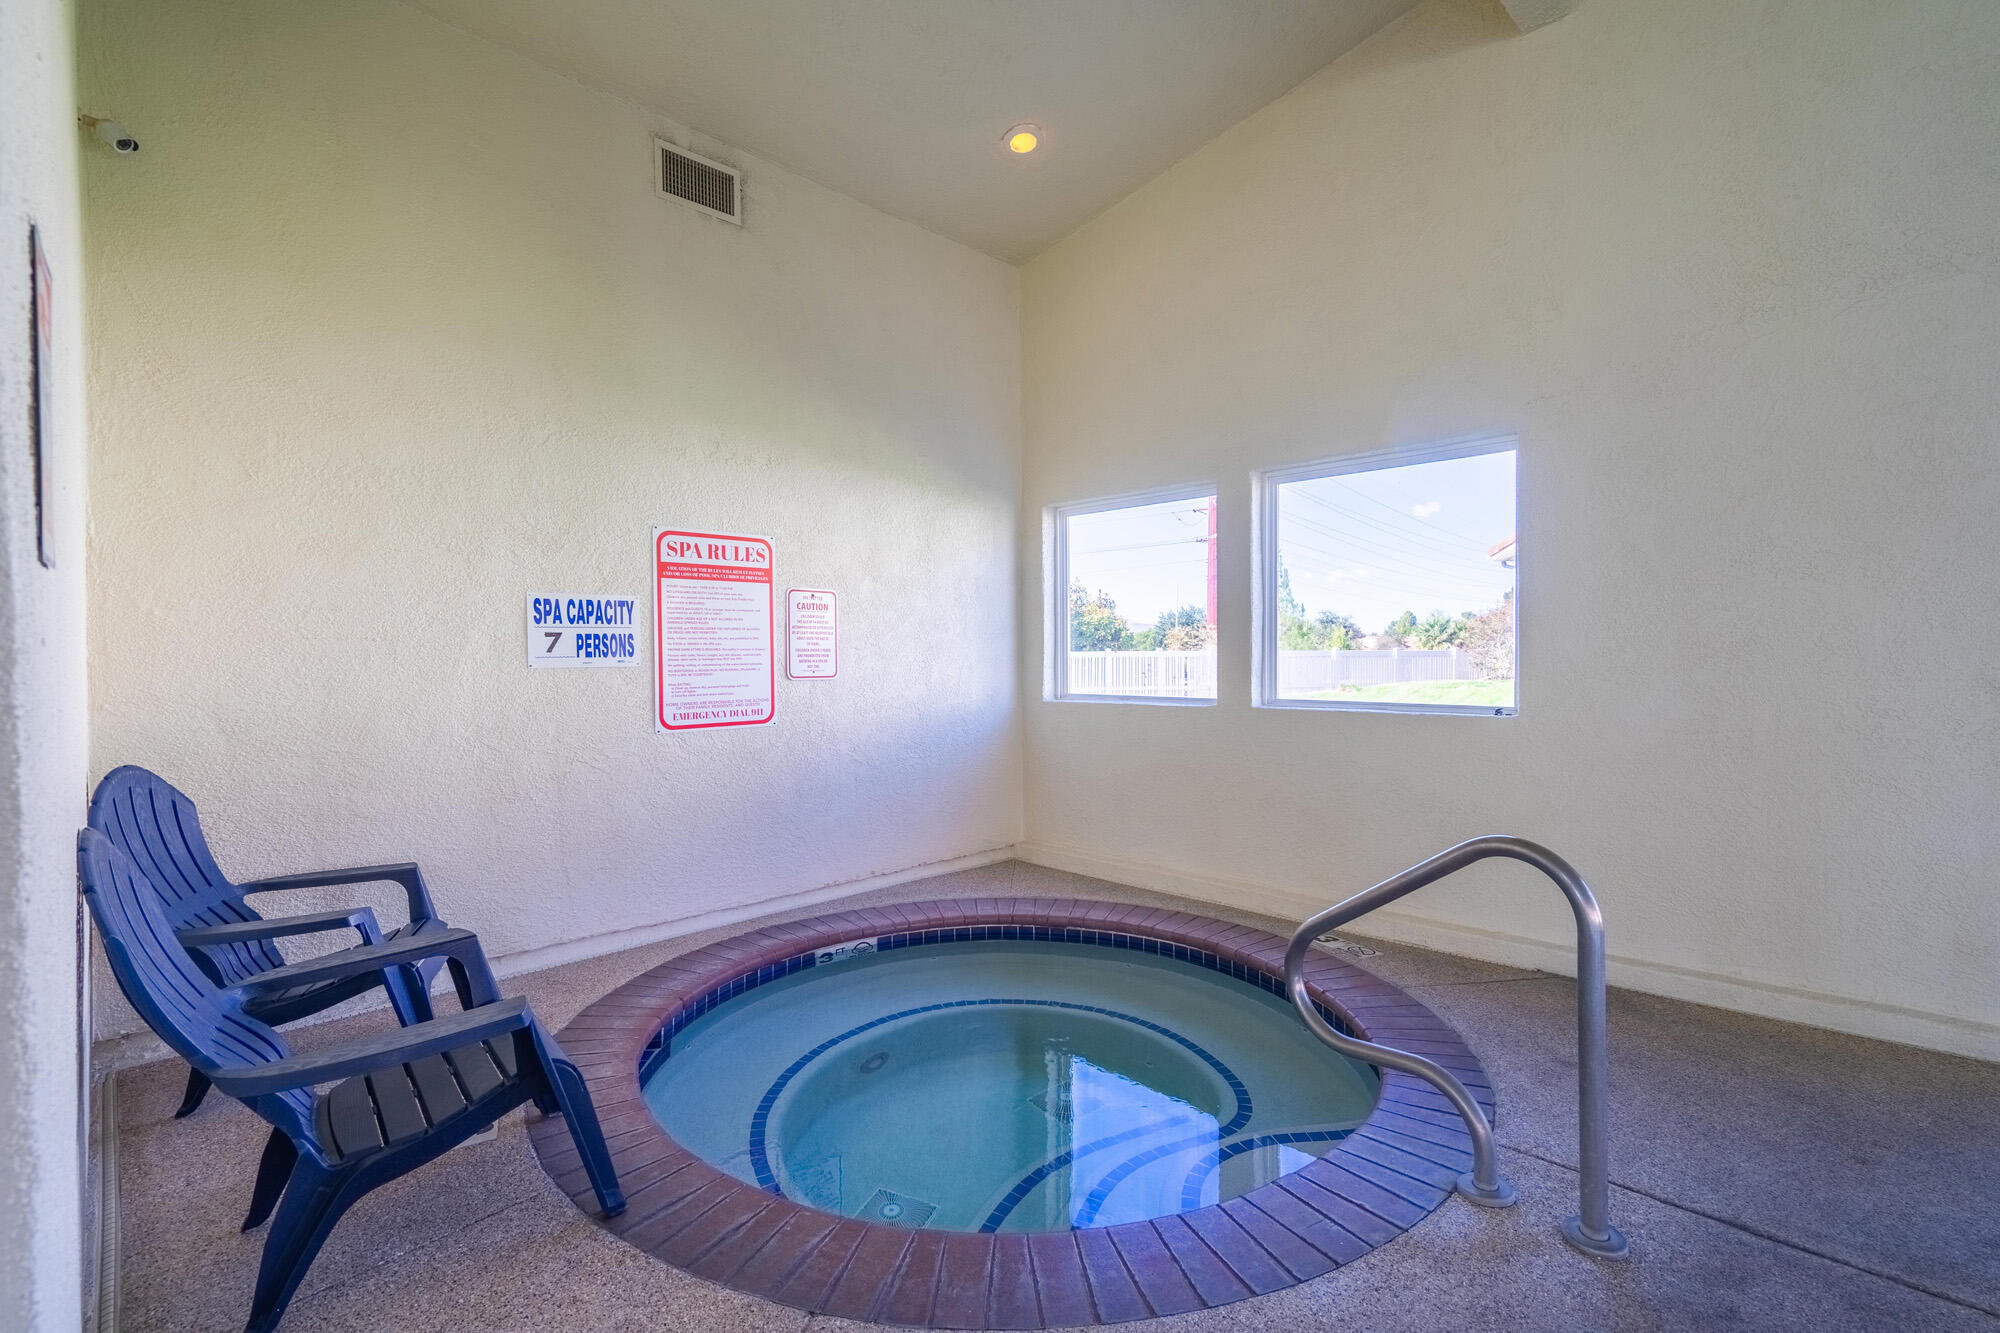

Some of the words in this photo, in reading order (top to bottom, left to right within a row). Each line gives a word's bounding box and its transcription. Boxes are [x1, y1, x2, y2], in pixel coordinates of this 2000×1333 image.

[665, 540, 703, 559] SPA
[708, 543, 766, 563] RULES
[533, 597, 563, 625] SPA
[566, 598, 635, 625] CAPACITY
[796, 601, 829, 611] CAUTION
[543, 631, 563, 654] 7
[576, 632, 635, 659] PERSONS
[673, 710, 727, 721] EMERGENCY
[729, 708, 750, 718] DIAL
[751, 707, 764, 716] 911
[819, 951, 834, 964] 3
